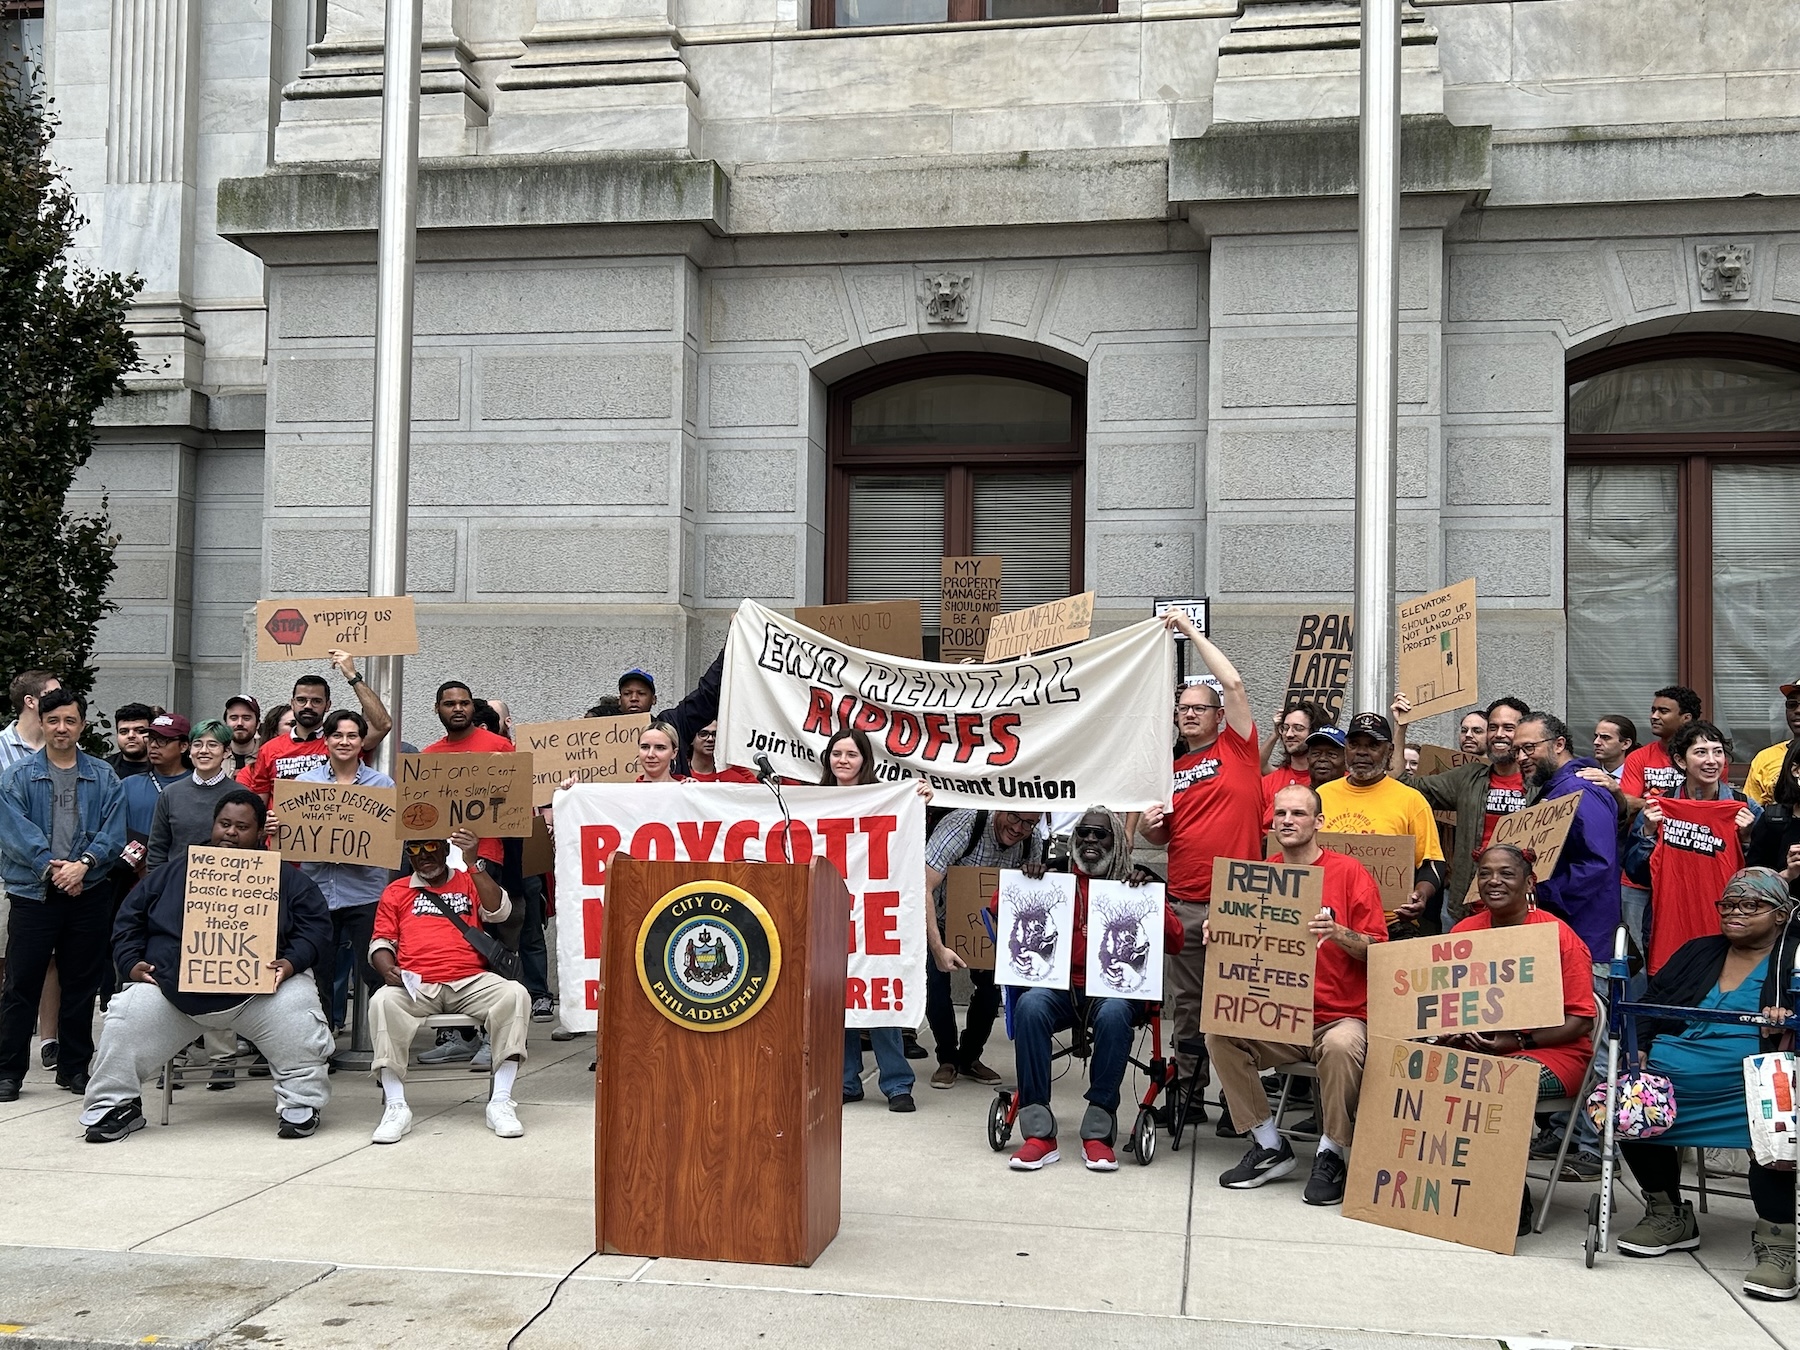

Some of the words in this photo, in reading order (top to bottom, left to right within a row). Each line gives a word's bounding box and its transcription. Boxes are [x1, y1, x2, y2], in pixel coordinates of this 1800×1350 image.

[955, 561, 981, 576] MY
[942, 589, 997, 600] MANAGER
[943, 577, 1001, 589] PROPERTY
[944, 601, 981, 612] SHOULD
[983, 602, 1001, 612] NOT
[1401, 594, 1452, 618] ELEVATORS
[1401, 614, 1437, 632] SHOULD
[1439, 608, 1451, 618] GO
[1456, 603, 1467, 613] UP
[271, 618, 305, 633] STOP
[313, 609, 368, 626] ripping
[374, 609, 392, 621] us
[820, 615, 844, 632] SAY
[852, 613, 871, 631] NO
[875, 612, 892, 630] TO
[953, 614, 966, 624] BE
[971, 614, 980, 625] A
[990, 613, 1017, 639] BAN
[1021, 602, 1066, 632] UNFAIR
[1402, 629, 1420, 643] NOT
[1425, 612, 1472, 634] LANDLORD
[336, 625, 368, 643] off!
[987, 632, 1032, 659] UTILITY
[1034, 625, 1065, 650] BILLS
[1295, 614, 1354, 651] BAN
[1403, 635, 1437, 653] PROFITS
[758, 622, 849, 688] END
[859, 657, 1080, 708] RENTAL
[1288, 653, 1351, 688] LATE
[567, 731, 600, 747] are
[605, 723, 644, 744] don
[803, 686, 1021, 766] RIPOFFS
[276, 762, 305, 771] TENANT
[565, 748, 598, 761] with
[625, 755, 642, 774] of
[747, 729, 786, 754] Join
[791, 739, 815, 762] the
[916, 769, 996, 796] Tenant
[998, 775, 1076, 799] Union
[403, 758, 442, 783] Not
[448, 765, 479, 779] one
[402, 786, 429, 800] for
[438, 784, 458, 798] the
[279, 788, 336, 813] TENANTS
[341, 790, 396, 823] DESERVE
[302, 812, 333, 820] WHAT
[339, 813, 355, 822] WE
[324, 804, 341, 813] GET
[450, 797, 506, 826] NOT
[505, 807, 524, 815] one
[1327, 812, 1350, 829] RENTERS
[1353, 813, 1371, 826] UNITED
[1496, 812, 1533, 842] OUR
[1531, 794, 1580, 831] HOMES
[278, 824, 323, 853] PAY
[330, 828, 371, 859] FOR
[580, 815, 898, 885] BOYCOTT
[1344, 843, 1396, 857] Deserve
[1527, 827, 1555, 849] NOT
[1690, 832, 1723, 847] UNION
[1693, 841, 1713, 852] DSA
[220, 856, 263, 870] can't
[189, 868, 242, 883] afford
[246, 875, 275, 885] our
[1227, 861, 1310, 899] RENT
[188, 881, 228, 897] basic
[232, 888, 279, 901] needs
[186, 901, 238, 919] paying
[243, 904, 268, 916] all
[671, 896, 704, 917] CITY
[711, 899, 732, 914] OF
[1218, 901, 1257, 919] JUNK
[1260, 905, 1302, 925] FEES
[205, 916, 249, 931] these
[187, 931, 259, 959] JUNK
[1209, 931, 1264, 949] UTILITY
[1265, 936, 1306, 956] FEES
[1431, 939, 1473, 962] NO
[188, 959, 260, 986] FEES!
[1218, 962, 1260, 983] LATE
[1264, 969, 1310, 988] FEES
[1393, 956, 1535, 996] SURPRISE
[653, 976, 763, 1021] PHILADELPHIA
[1416, 987, 1505, 1030] FEES
[1213, 994, 1312, 1033] RIPOFF
[1389, 1045, 1519, 1094] ROBBERY
[1393, 1088, 1424, 1121] IN
[1444, 1095, 1503, 1134] THE
[1398, 1128, 1471, 1167] FINE
[1373, 1169, 1471, 1217] PRINT
